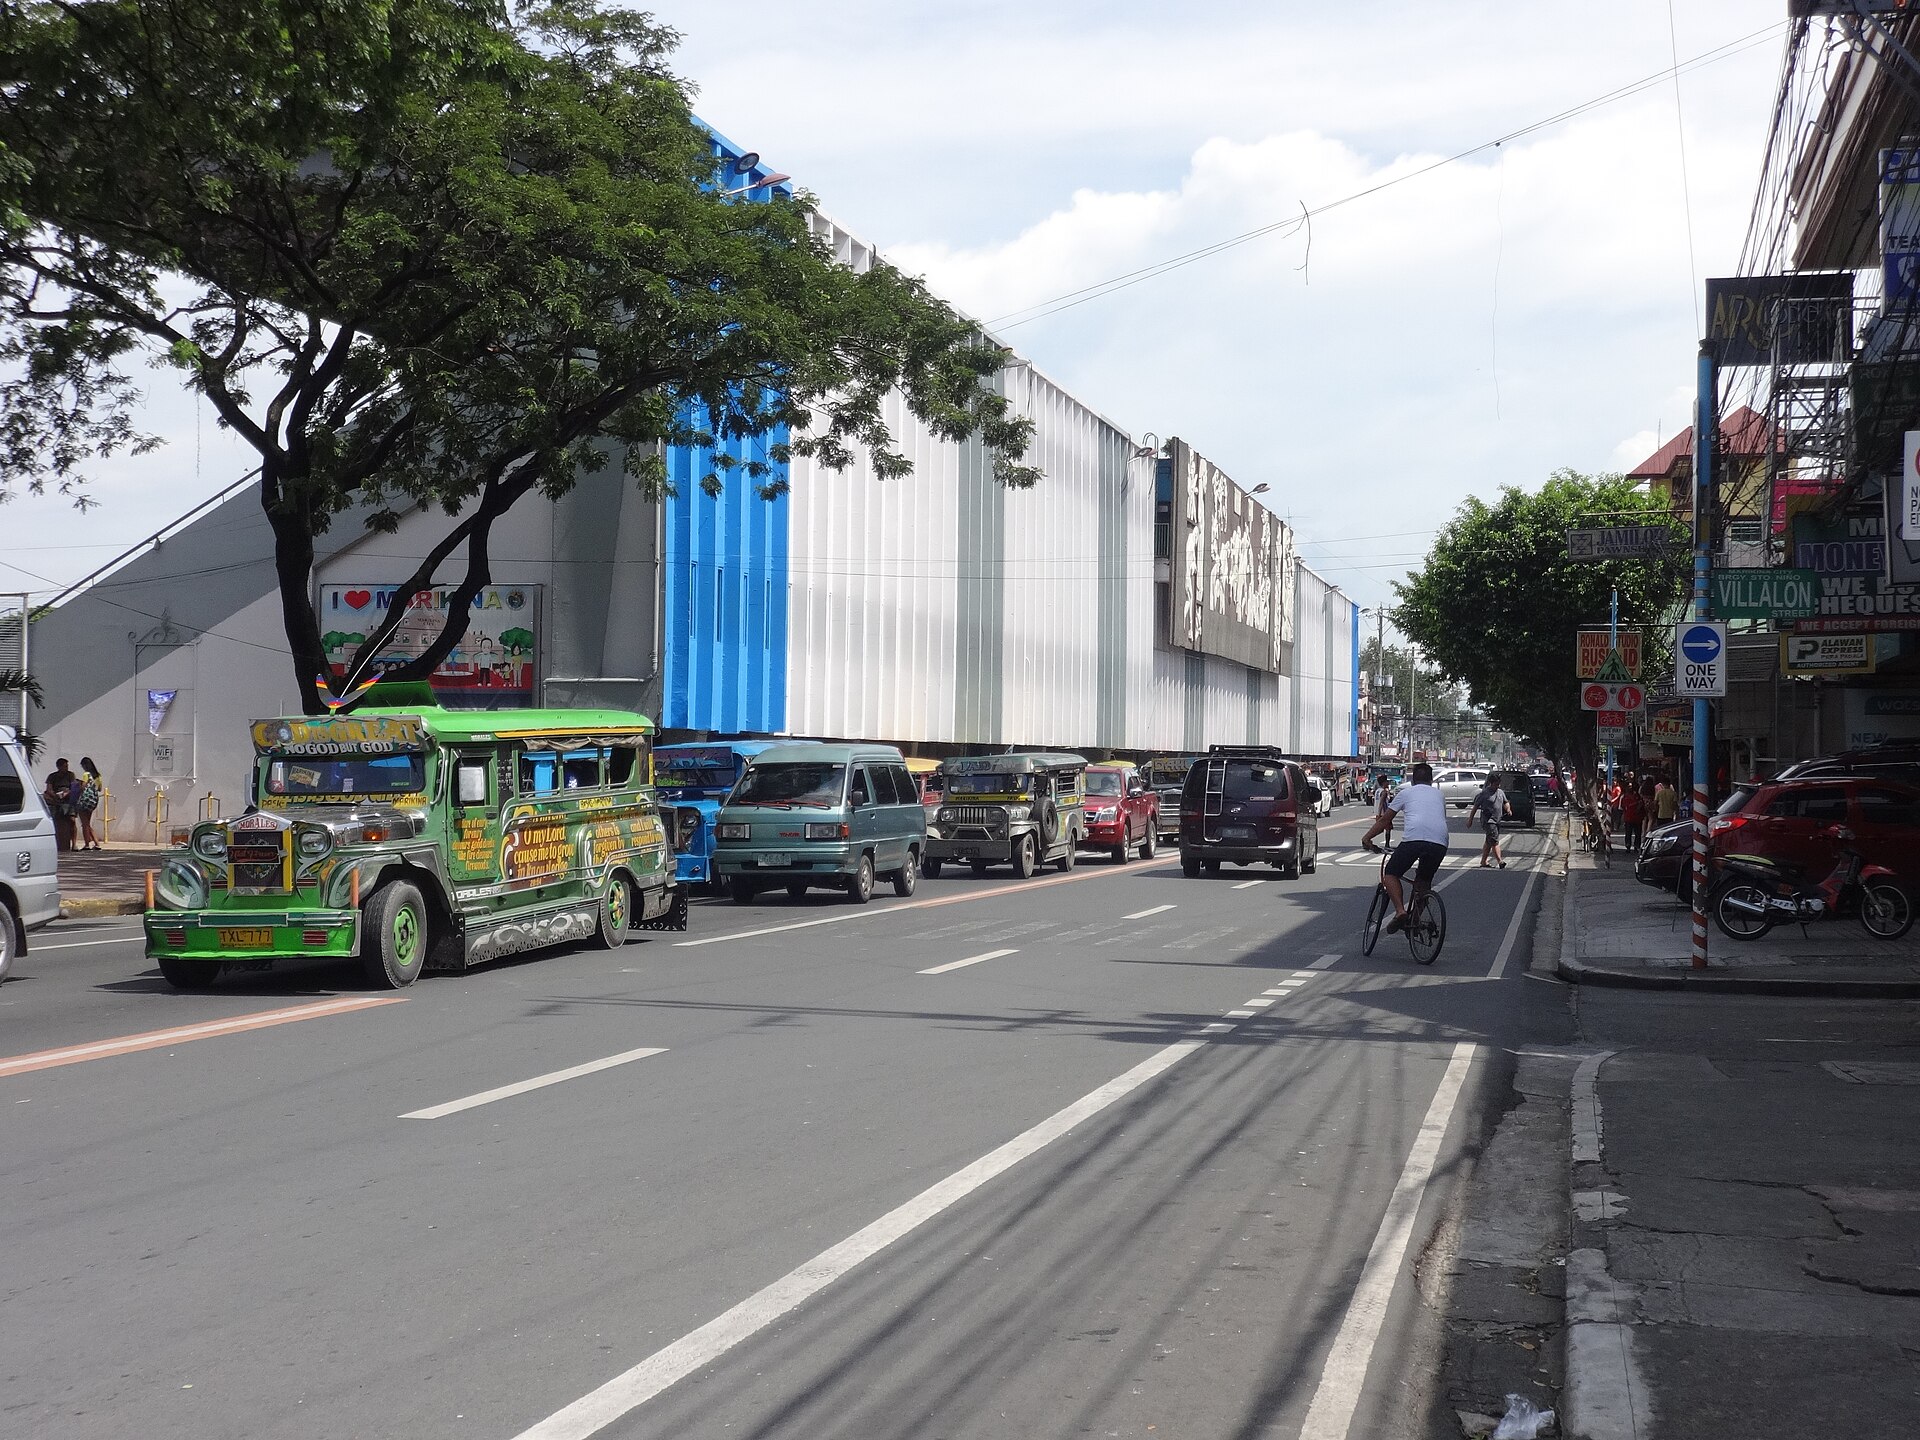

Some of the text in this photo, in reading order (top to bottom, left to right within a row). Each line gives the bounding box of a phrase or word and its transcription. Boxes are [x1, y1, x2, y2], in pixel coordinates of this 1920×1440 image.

[1820, 577, 1866, 596] WE
[332, 591, 339, 610] I
[1718, 580, 1811, 608] VILLALON
[1770, 609, 1812, 618] STREET
[1800, 622, 1820, 631] WE
[1823, 620, 1869, 631] ACCEPT
[1615, 634, 1639, 648] TUDIO
[1821, 646, 1864, 654] EXPRESS
[1685, 664, 1716, 676] ONE
[1685, 676, 1716, 689] WAY
[285, 743, 307, 755] NO
[305, 741, 340, 755] GOD
[359, 741, 394, 753] GOD
[240, 817, 277, 828] MORALES
[514, 848, 538, 865] cause
